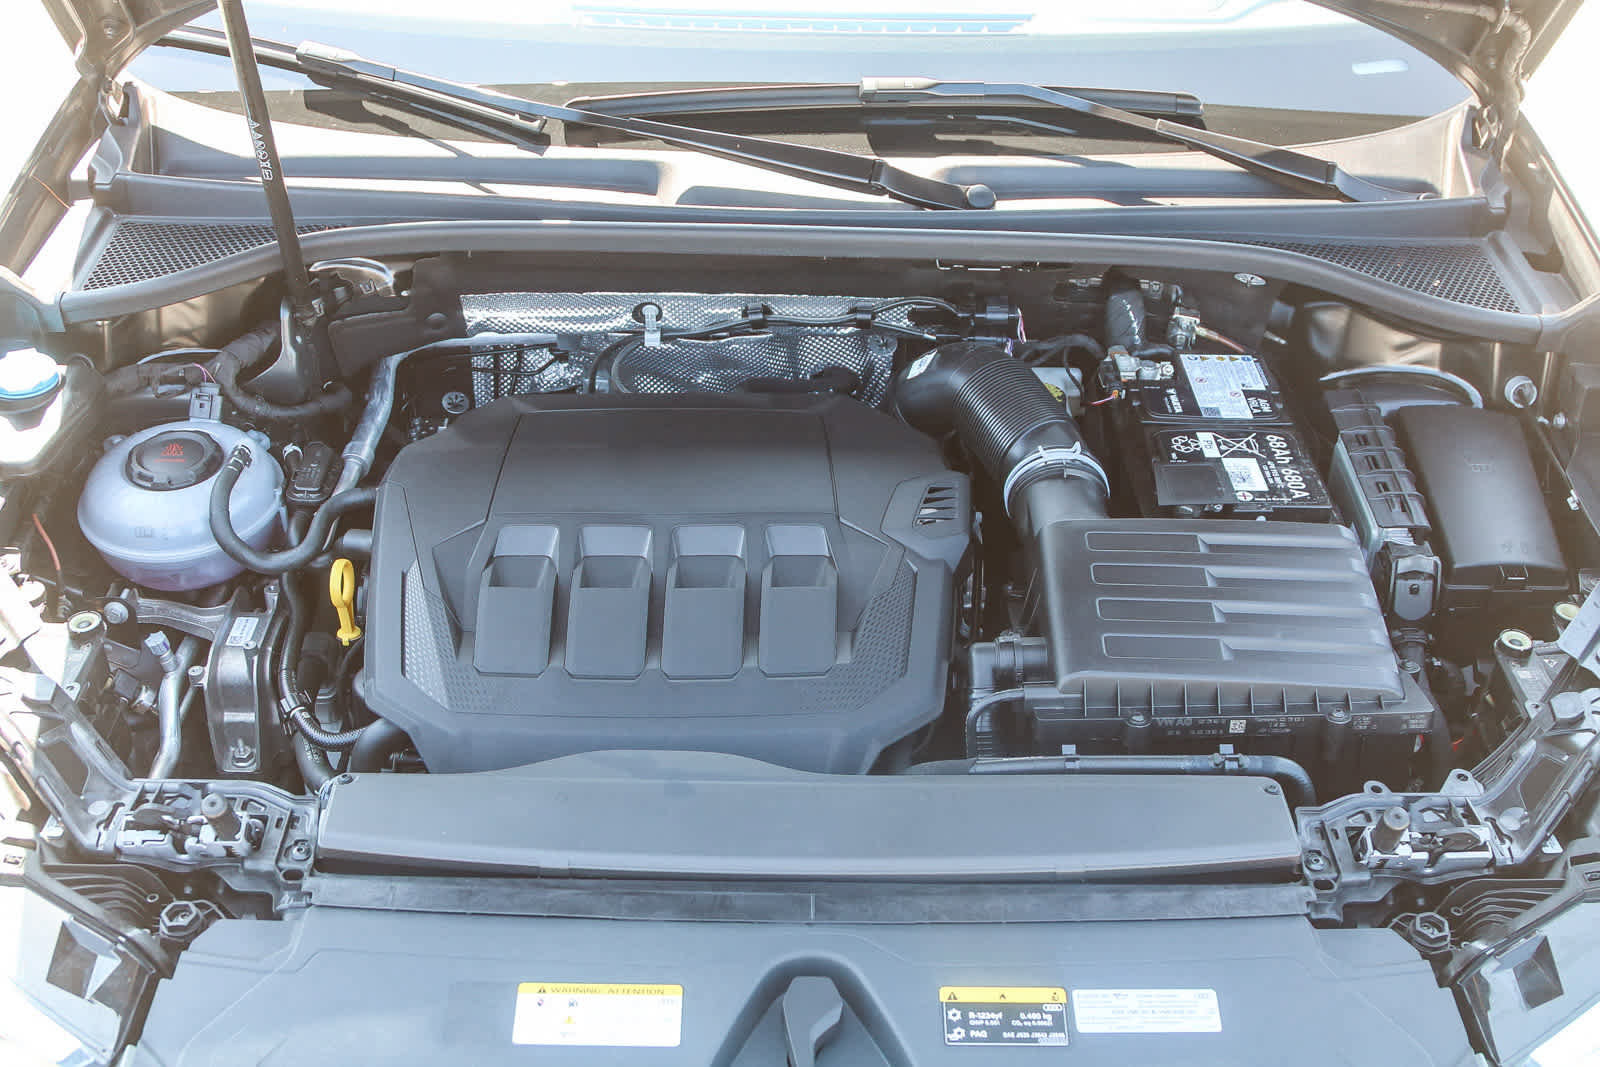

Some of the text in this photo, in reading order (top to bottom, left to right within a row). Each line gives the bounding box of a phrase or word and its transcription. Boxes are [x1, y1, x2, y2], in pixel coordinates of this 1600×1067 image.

[1258, 398, 1273, 413] AGM
[1266, 434, 1294, 464] 68Ah
[1281, 468, 1310, 499] 680A
[969, 1029, 988, 1038] PAG
